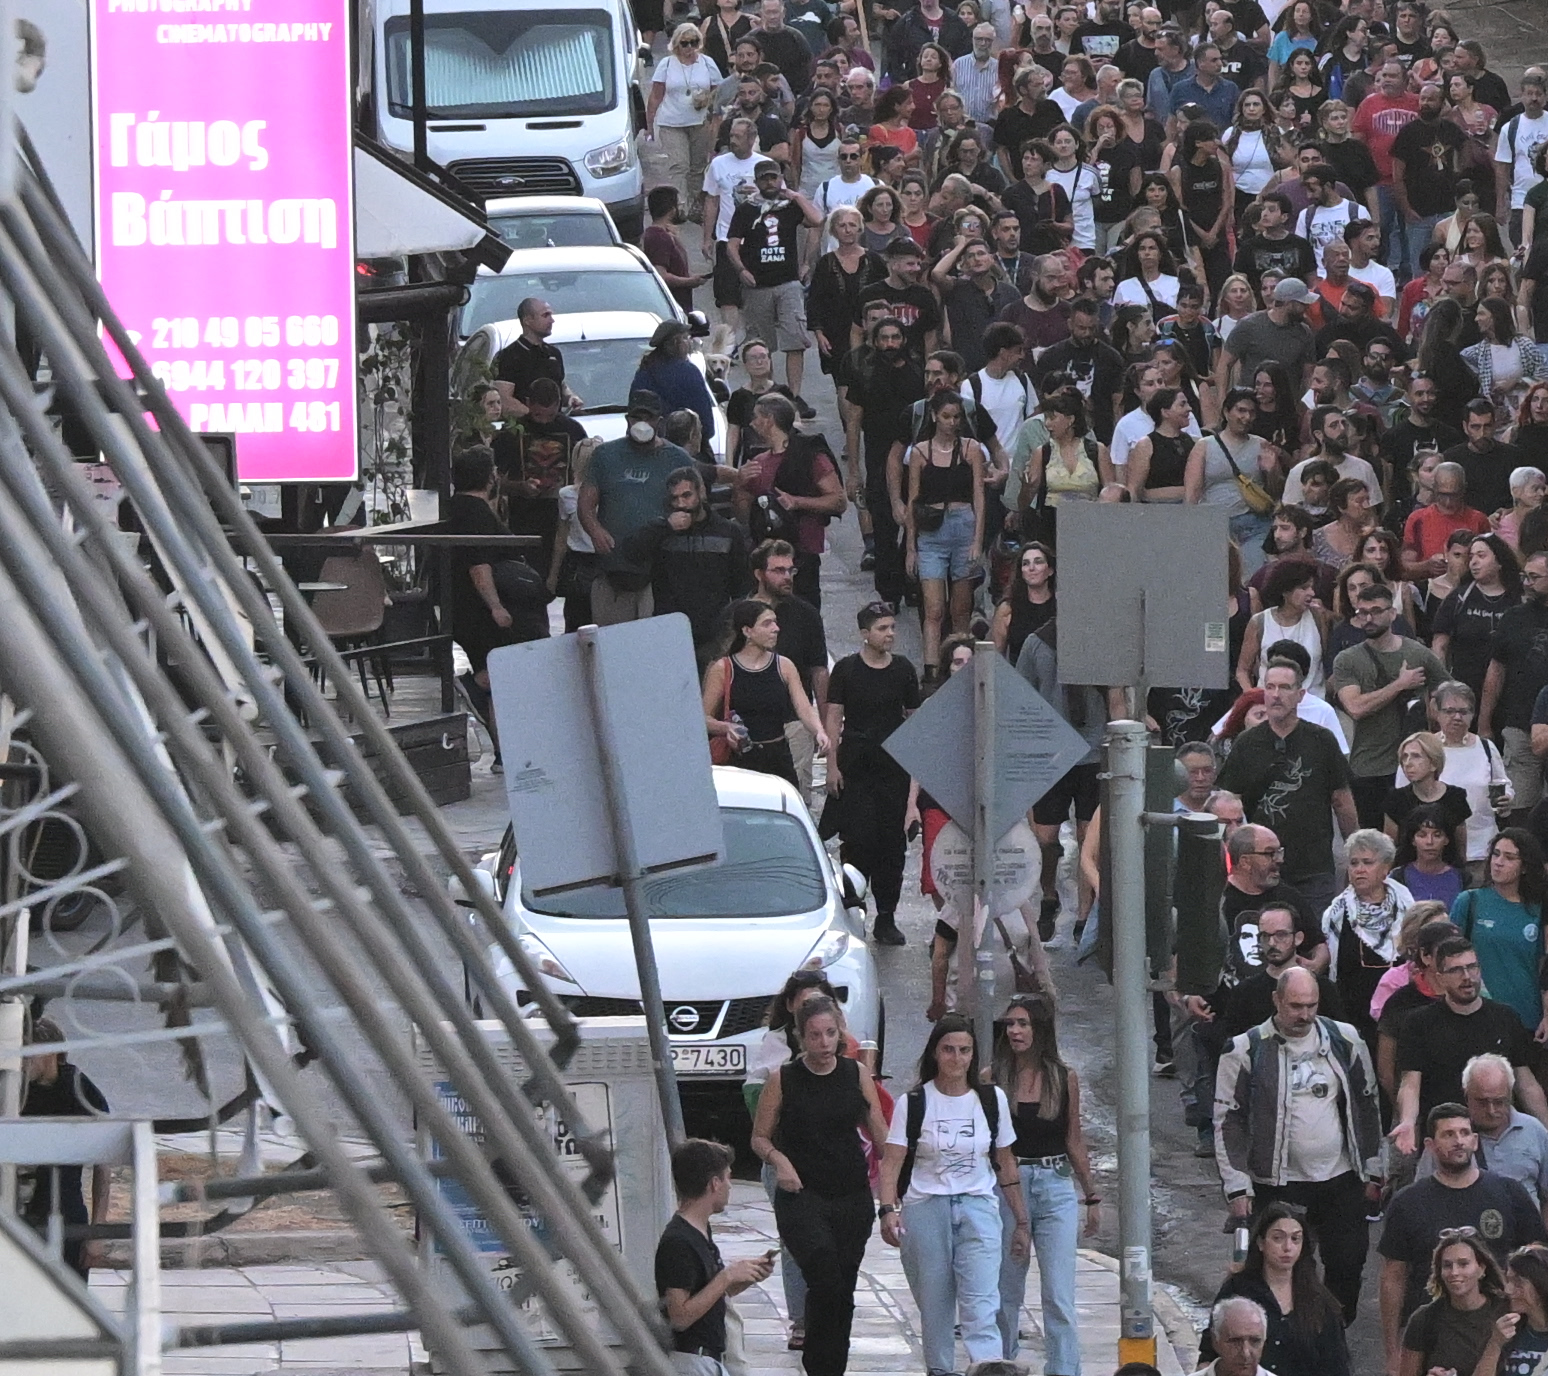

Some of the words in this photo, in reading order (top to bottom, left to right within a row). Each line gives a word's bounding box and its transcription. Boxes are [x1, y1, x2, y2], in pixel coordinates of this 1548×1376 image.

[156, 22, 332, 44] CINEMATOGRAPHY
[109, 110, 269, 172] Γάμος
[112, 189, 337, 249] Βάπτιση
